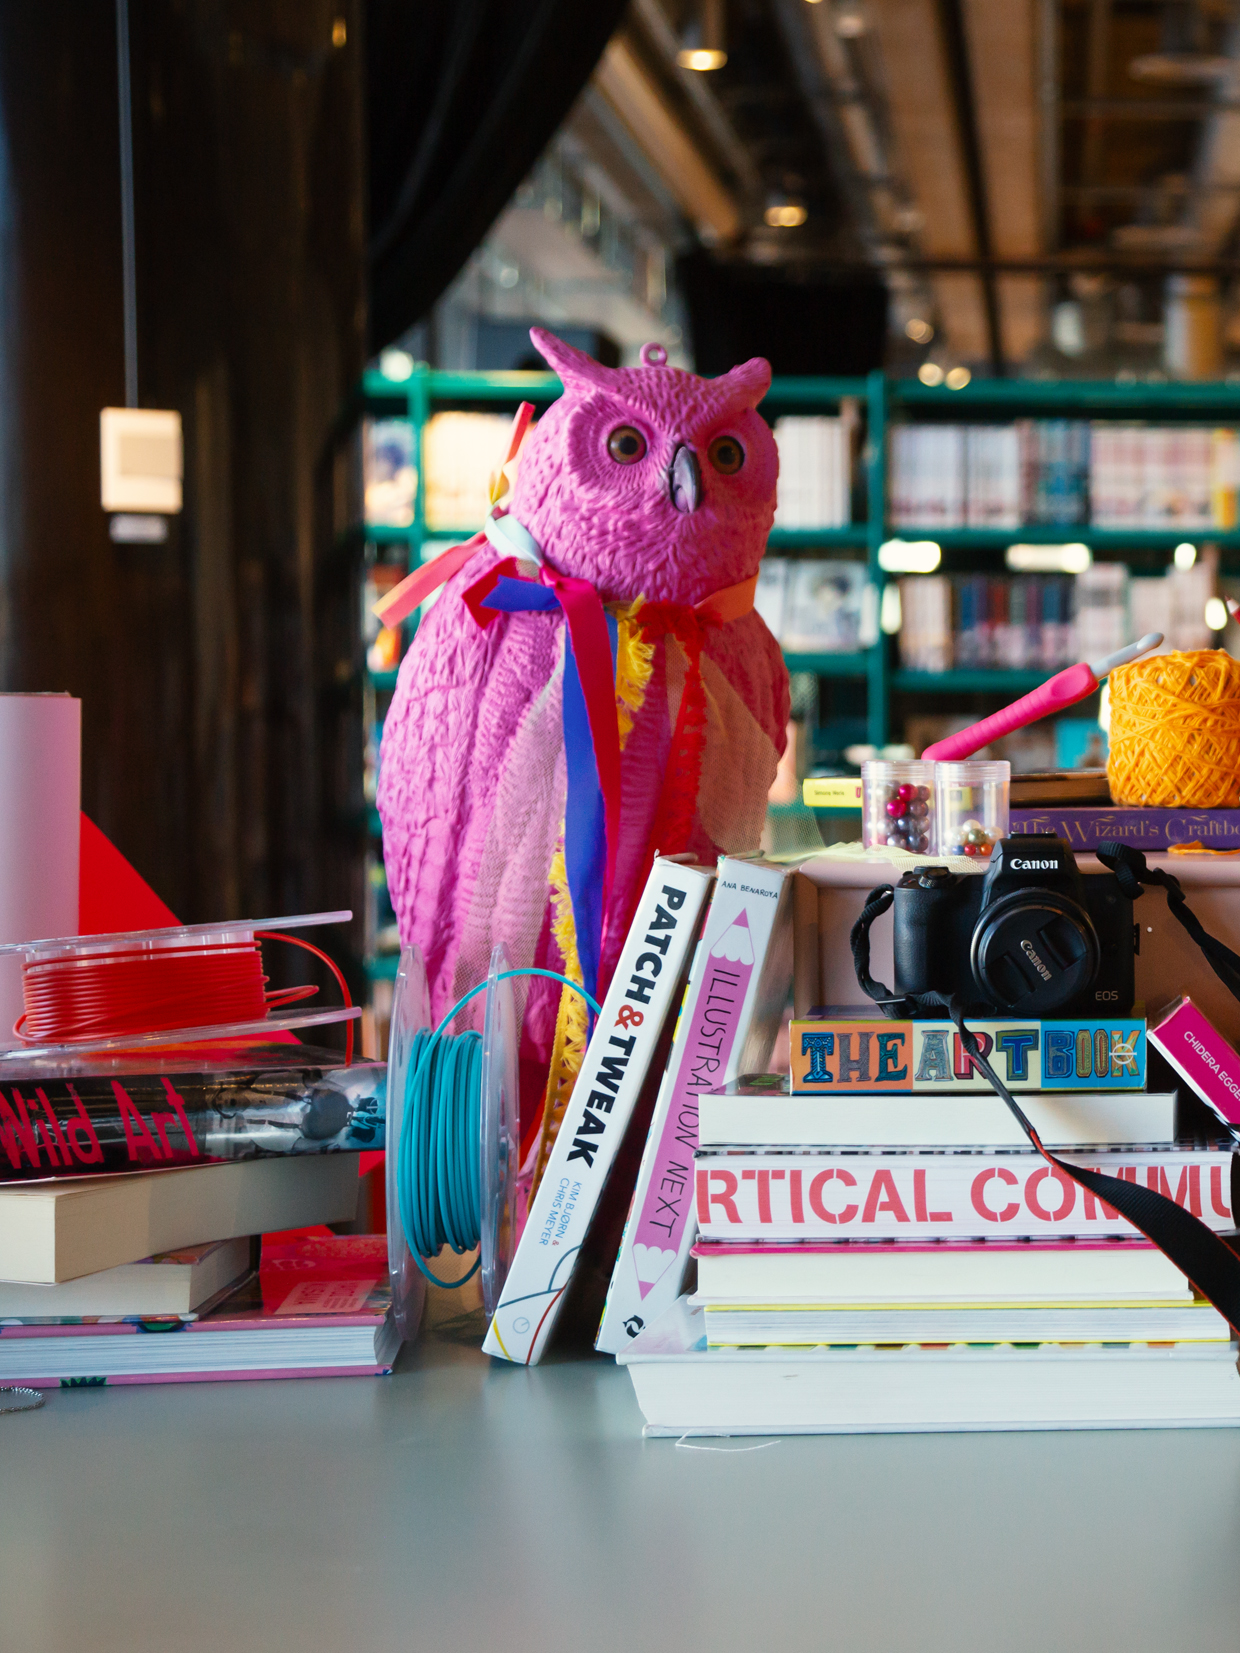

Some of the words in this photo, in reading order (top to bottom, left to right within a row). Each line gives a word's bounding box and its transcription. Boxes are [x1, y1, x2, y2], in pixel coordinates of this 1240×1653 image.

[1061, 816, 1159, 843] Wizard's
[1010, 858, 1059, 870] Canon
[721, 880, 737, 890] ANA
[625, 884, 687, 1005] PATCH
[1020, 939, 1052, 982] Canon
[1095, 991, 1119, 1001] EOS
[613, 1004, 644, 1031] &
[801, 1031, 908, 1083] THE
[914, 1029, 1039, 1082] ART
[1044, 1028, 1141, 1079] BOOK
[1183, 1031, 1221, 1074] CHIDERA
[566, 1035, 637, 1169] TWEAK
[0, 1083, 105, 1169] Wild
[110, 1077, 199, 1161] Art
[552, 1177, 570, 1209] CHRIS
[568, 1181, 582, 1201] KIM
[649, 1160, 689, 1238] NEXT
[696, 1168, 952, 1225] RTICAL
[539, 1210, 559, 1246] MEYER
[556, 1202, 575, 1239] BJØRN
